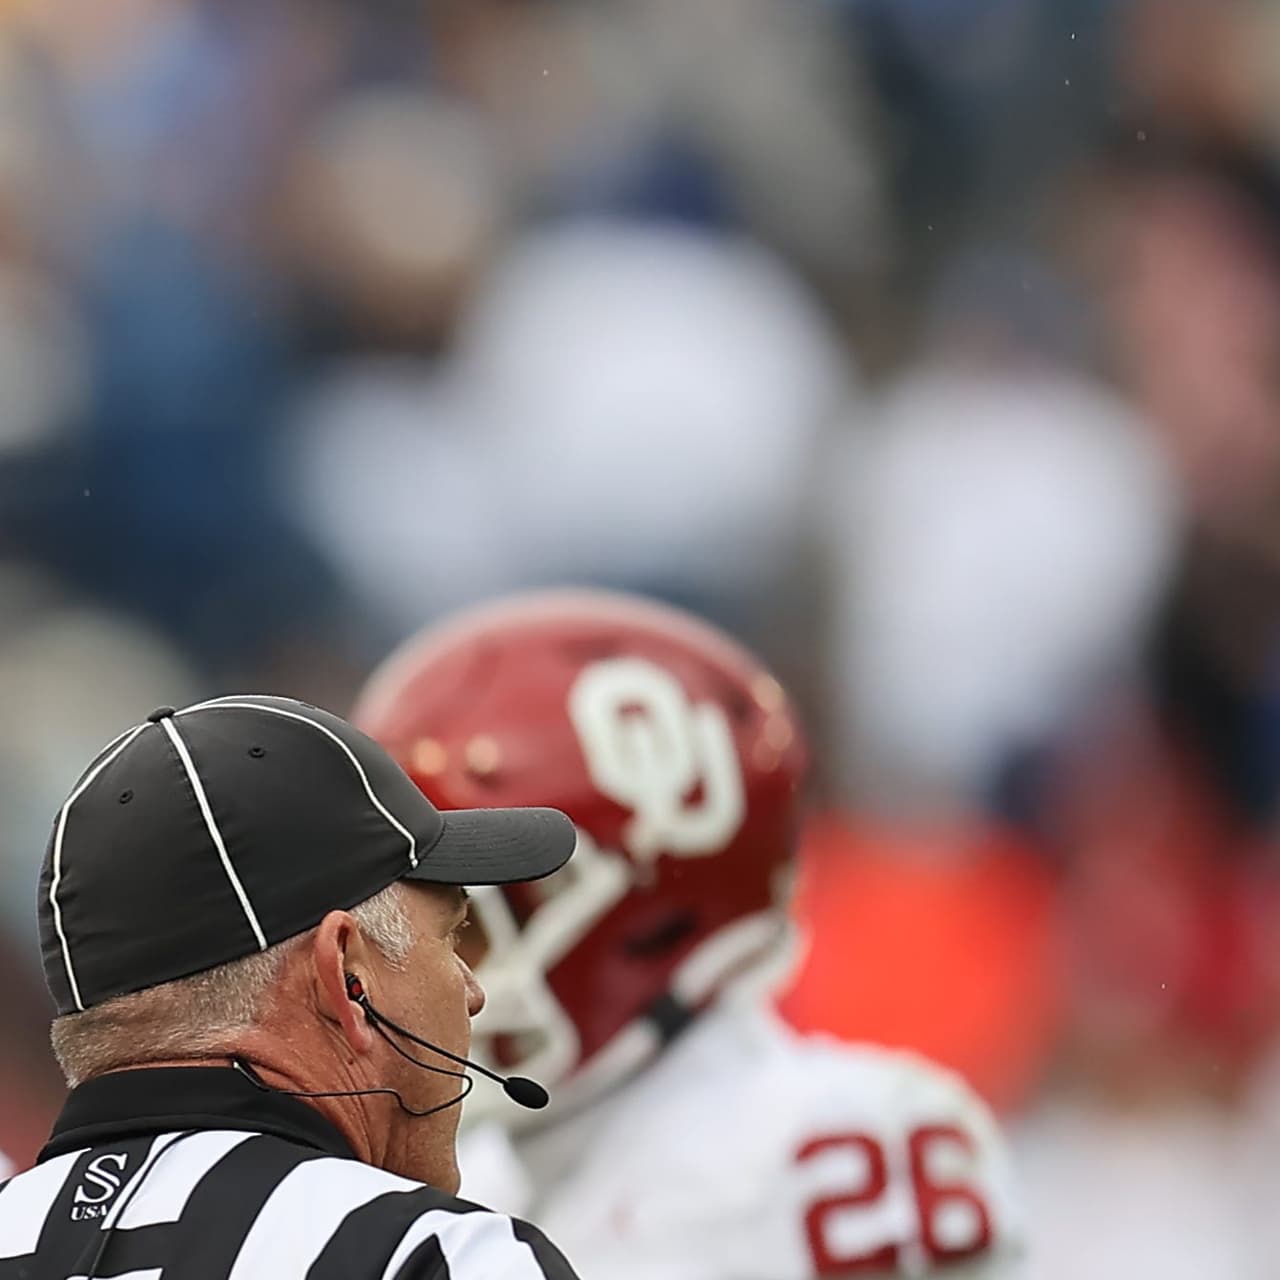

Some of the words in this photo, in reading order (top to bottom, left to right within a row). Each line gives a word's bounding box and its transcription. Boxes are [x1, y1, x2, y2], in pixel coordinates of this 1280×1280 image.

[569, 655, 746, 858] OU
[71, 1203, 108, 1220] USA
[792, 1124, 994, 1280] 26
